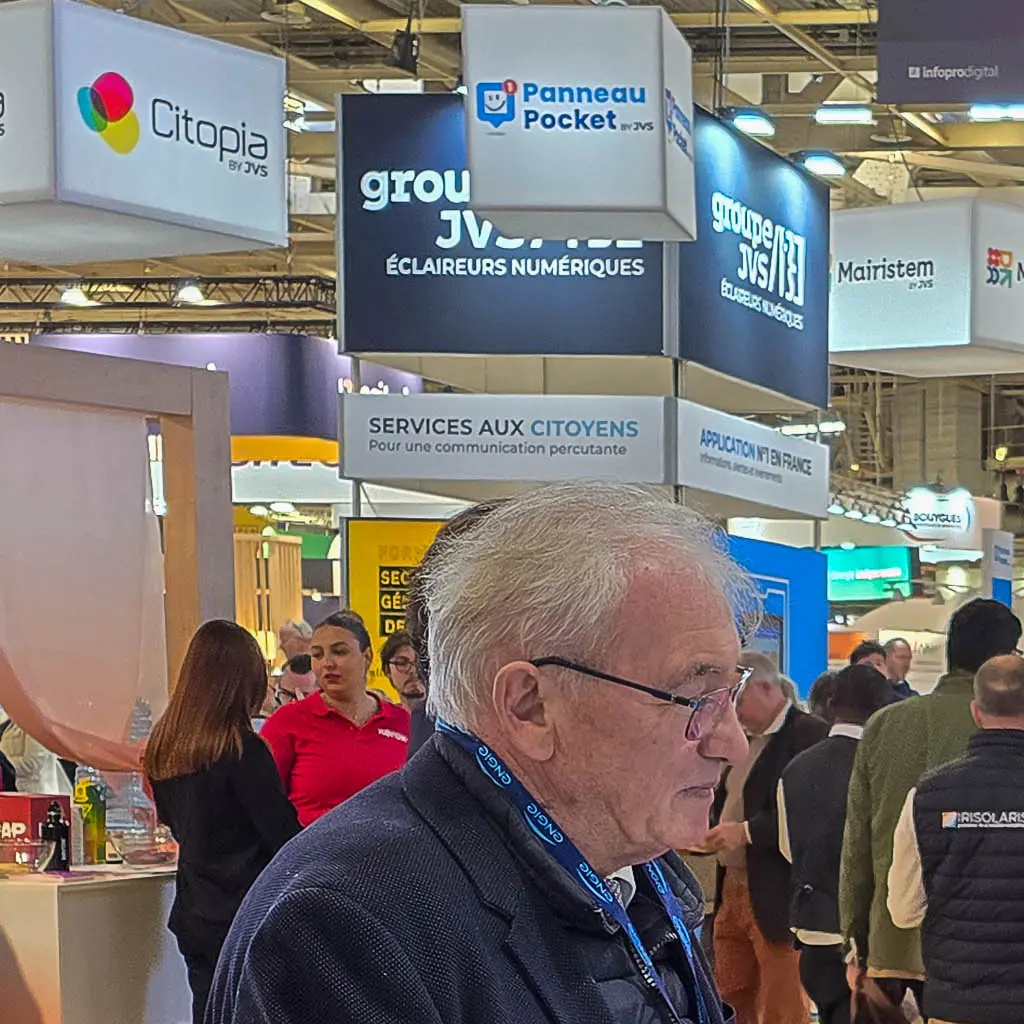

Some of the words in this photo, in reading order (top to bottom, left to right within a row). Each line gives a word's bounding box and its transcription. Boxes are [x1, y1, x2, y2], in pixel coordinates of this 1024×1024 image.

[523, 82, 646, 103] Panneau
[151, 98, 268, 162] Citopia
[524, 109, 617, 130] Pocket
[633, 122, 654, 131] JVS
[228, 160, 242, 173] BY
[244, 161, 268, 177] JVS
[360, 169, 471, 211] grou
[435, 209, 525, 249] JV
[711, 191, 773, 249] groupe
[386, 253, 507, 276] ÉCLAIREURS
[511, 255, 645, 278] NUMÉRIQUES
[838, 258, 934, 283] Mairistem
[369, 417, 473, 436] SERVICES
[478, 419, 525, 437] AUX
[530, 420, 639, 438] CITOYENS
[369, 439, 401, 452] Pour
[405, 442, 431, 453] une
[435, 440, 546, 454] communication
[549, 443, 627, 457] percutante
[700, 429, 755, 460] APPLICATION
[782, 452, 812, 476] FRANCE
